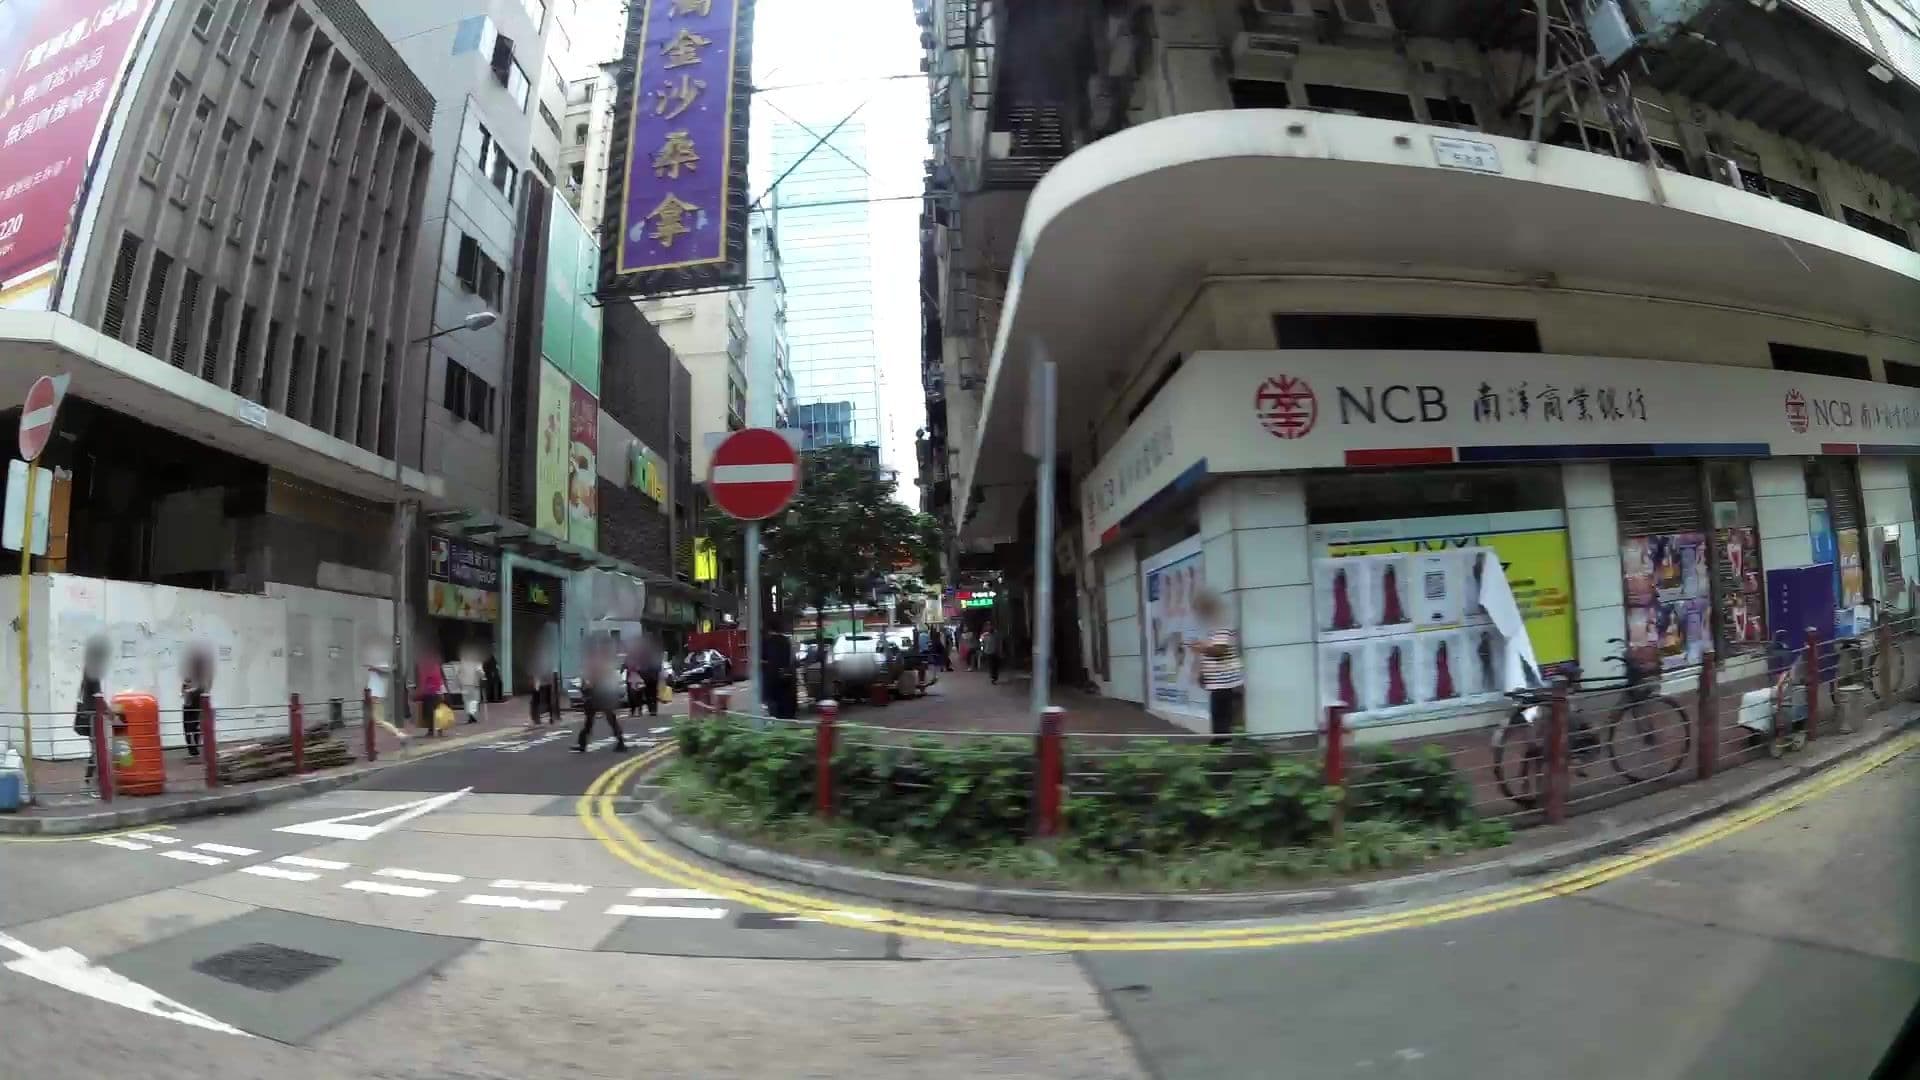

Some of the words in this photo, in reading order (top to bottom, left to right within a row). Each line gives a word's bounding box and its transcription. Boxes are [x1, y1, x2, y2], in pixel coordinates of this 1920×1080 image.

[1336, 384, 1448, 425] NCB
[1473, 381, 1647, 423] 南洋商業銀行
[1813, 400, 1853, 428] NCB
